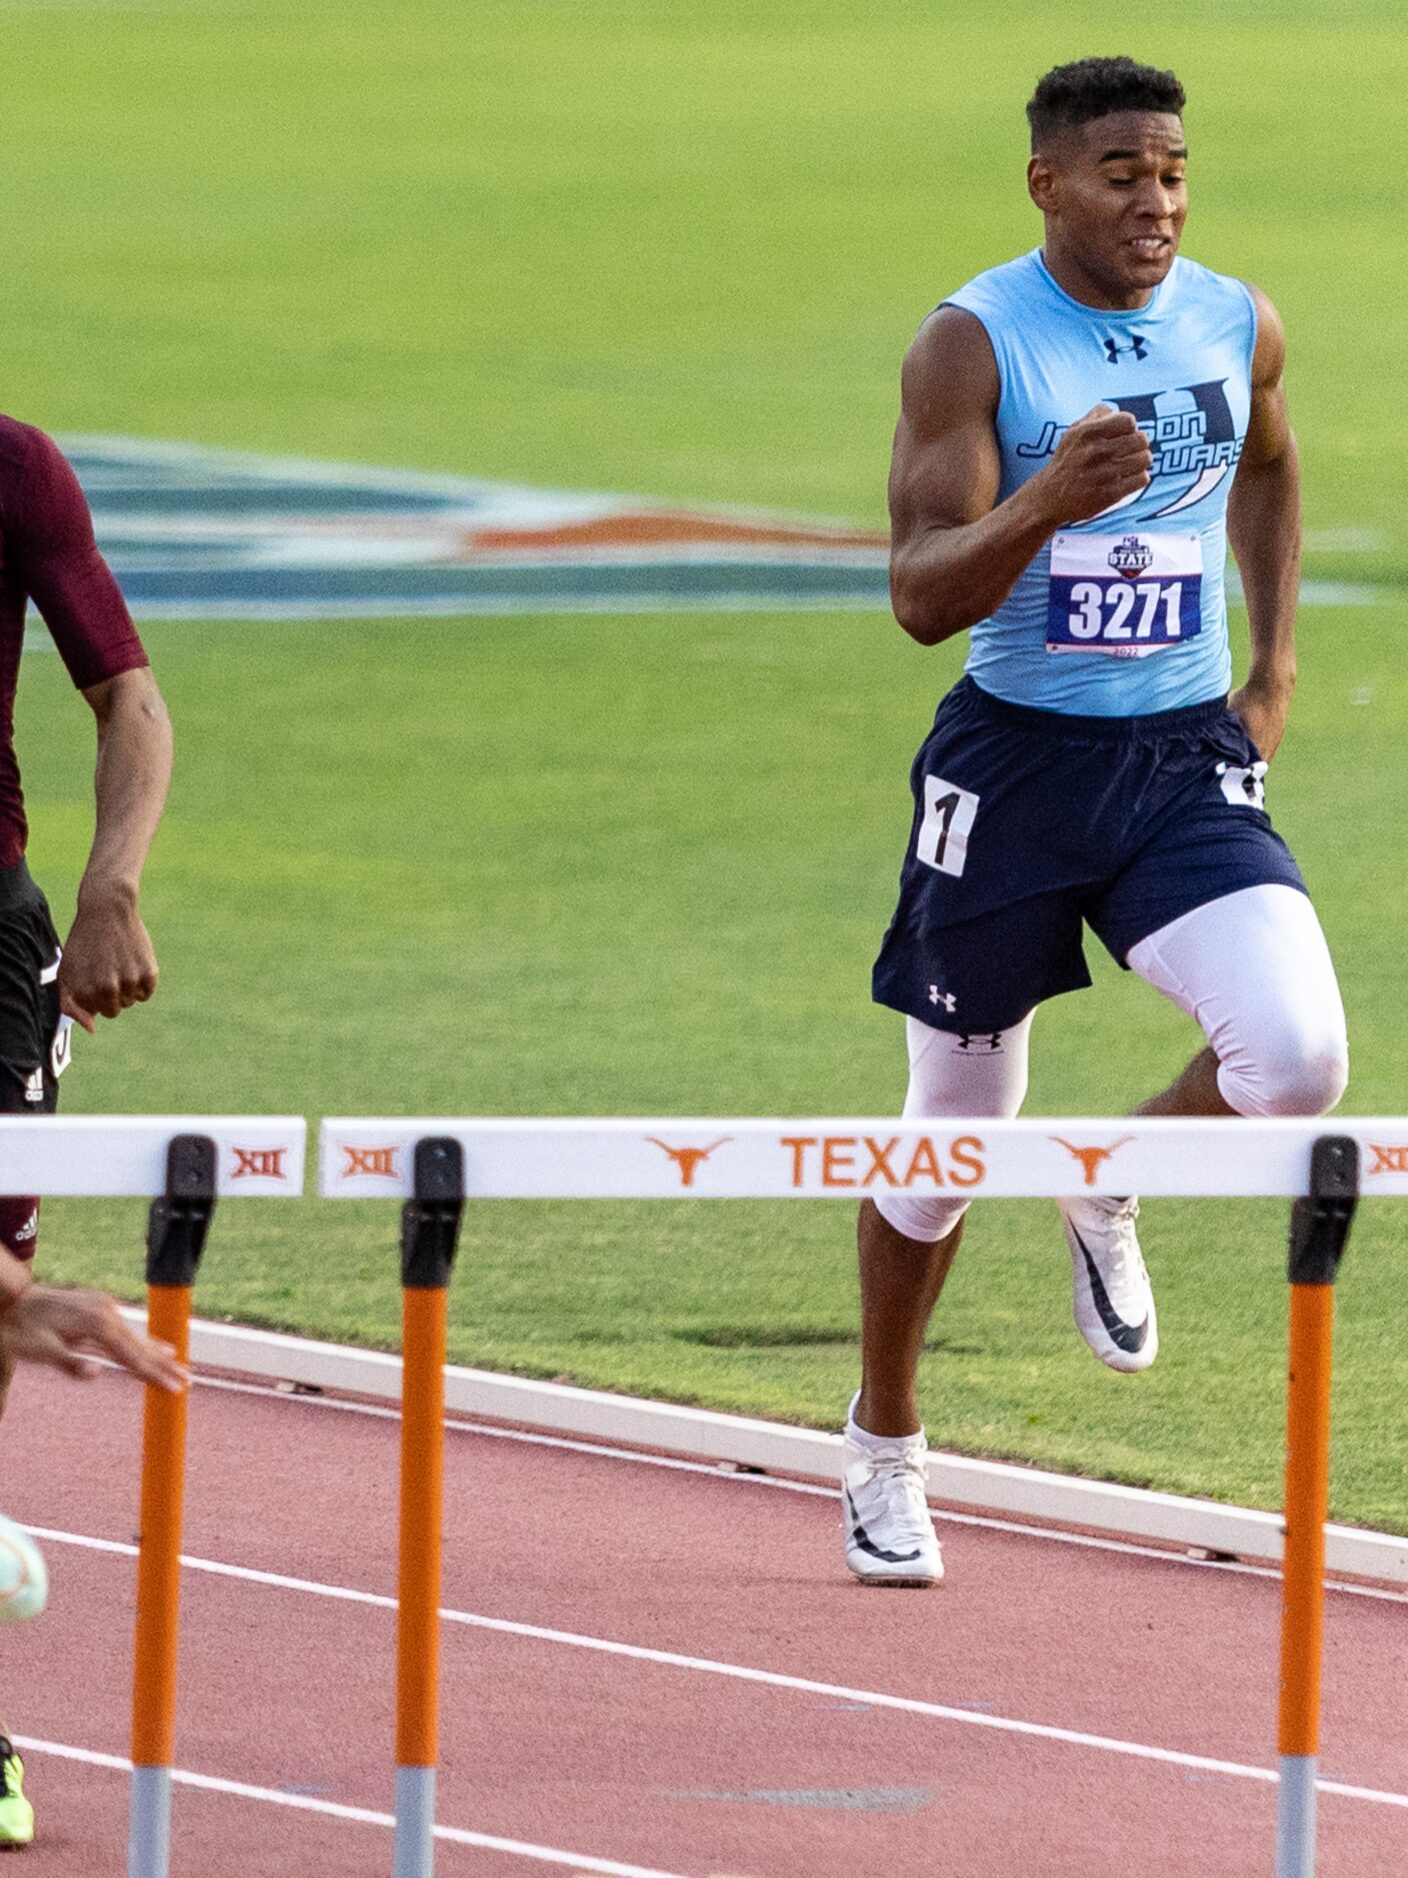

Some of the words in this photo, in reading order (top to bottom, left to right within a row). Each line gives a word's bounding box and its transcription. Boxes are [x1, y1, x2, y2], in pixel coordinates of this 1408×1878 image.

[1016, 409, 1206, 458] JSON
[1109, 553, 1152, 565] STATE
[1069, 582, 1182, 638] 3271
[934, 791, 961, 867] 1
[779, 1135, 986, 1188] TEXAS
[1368, 1143, 1408, 1175] XI
